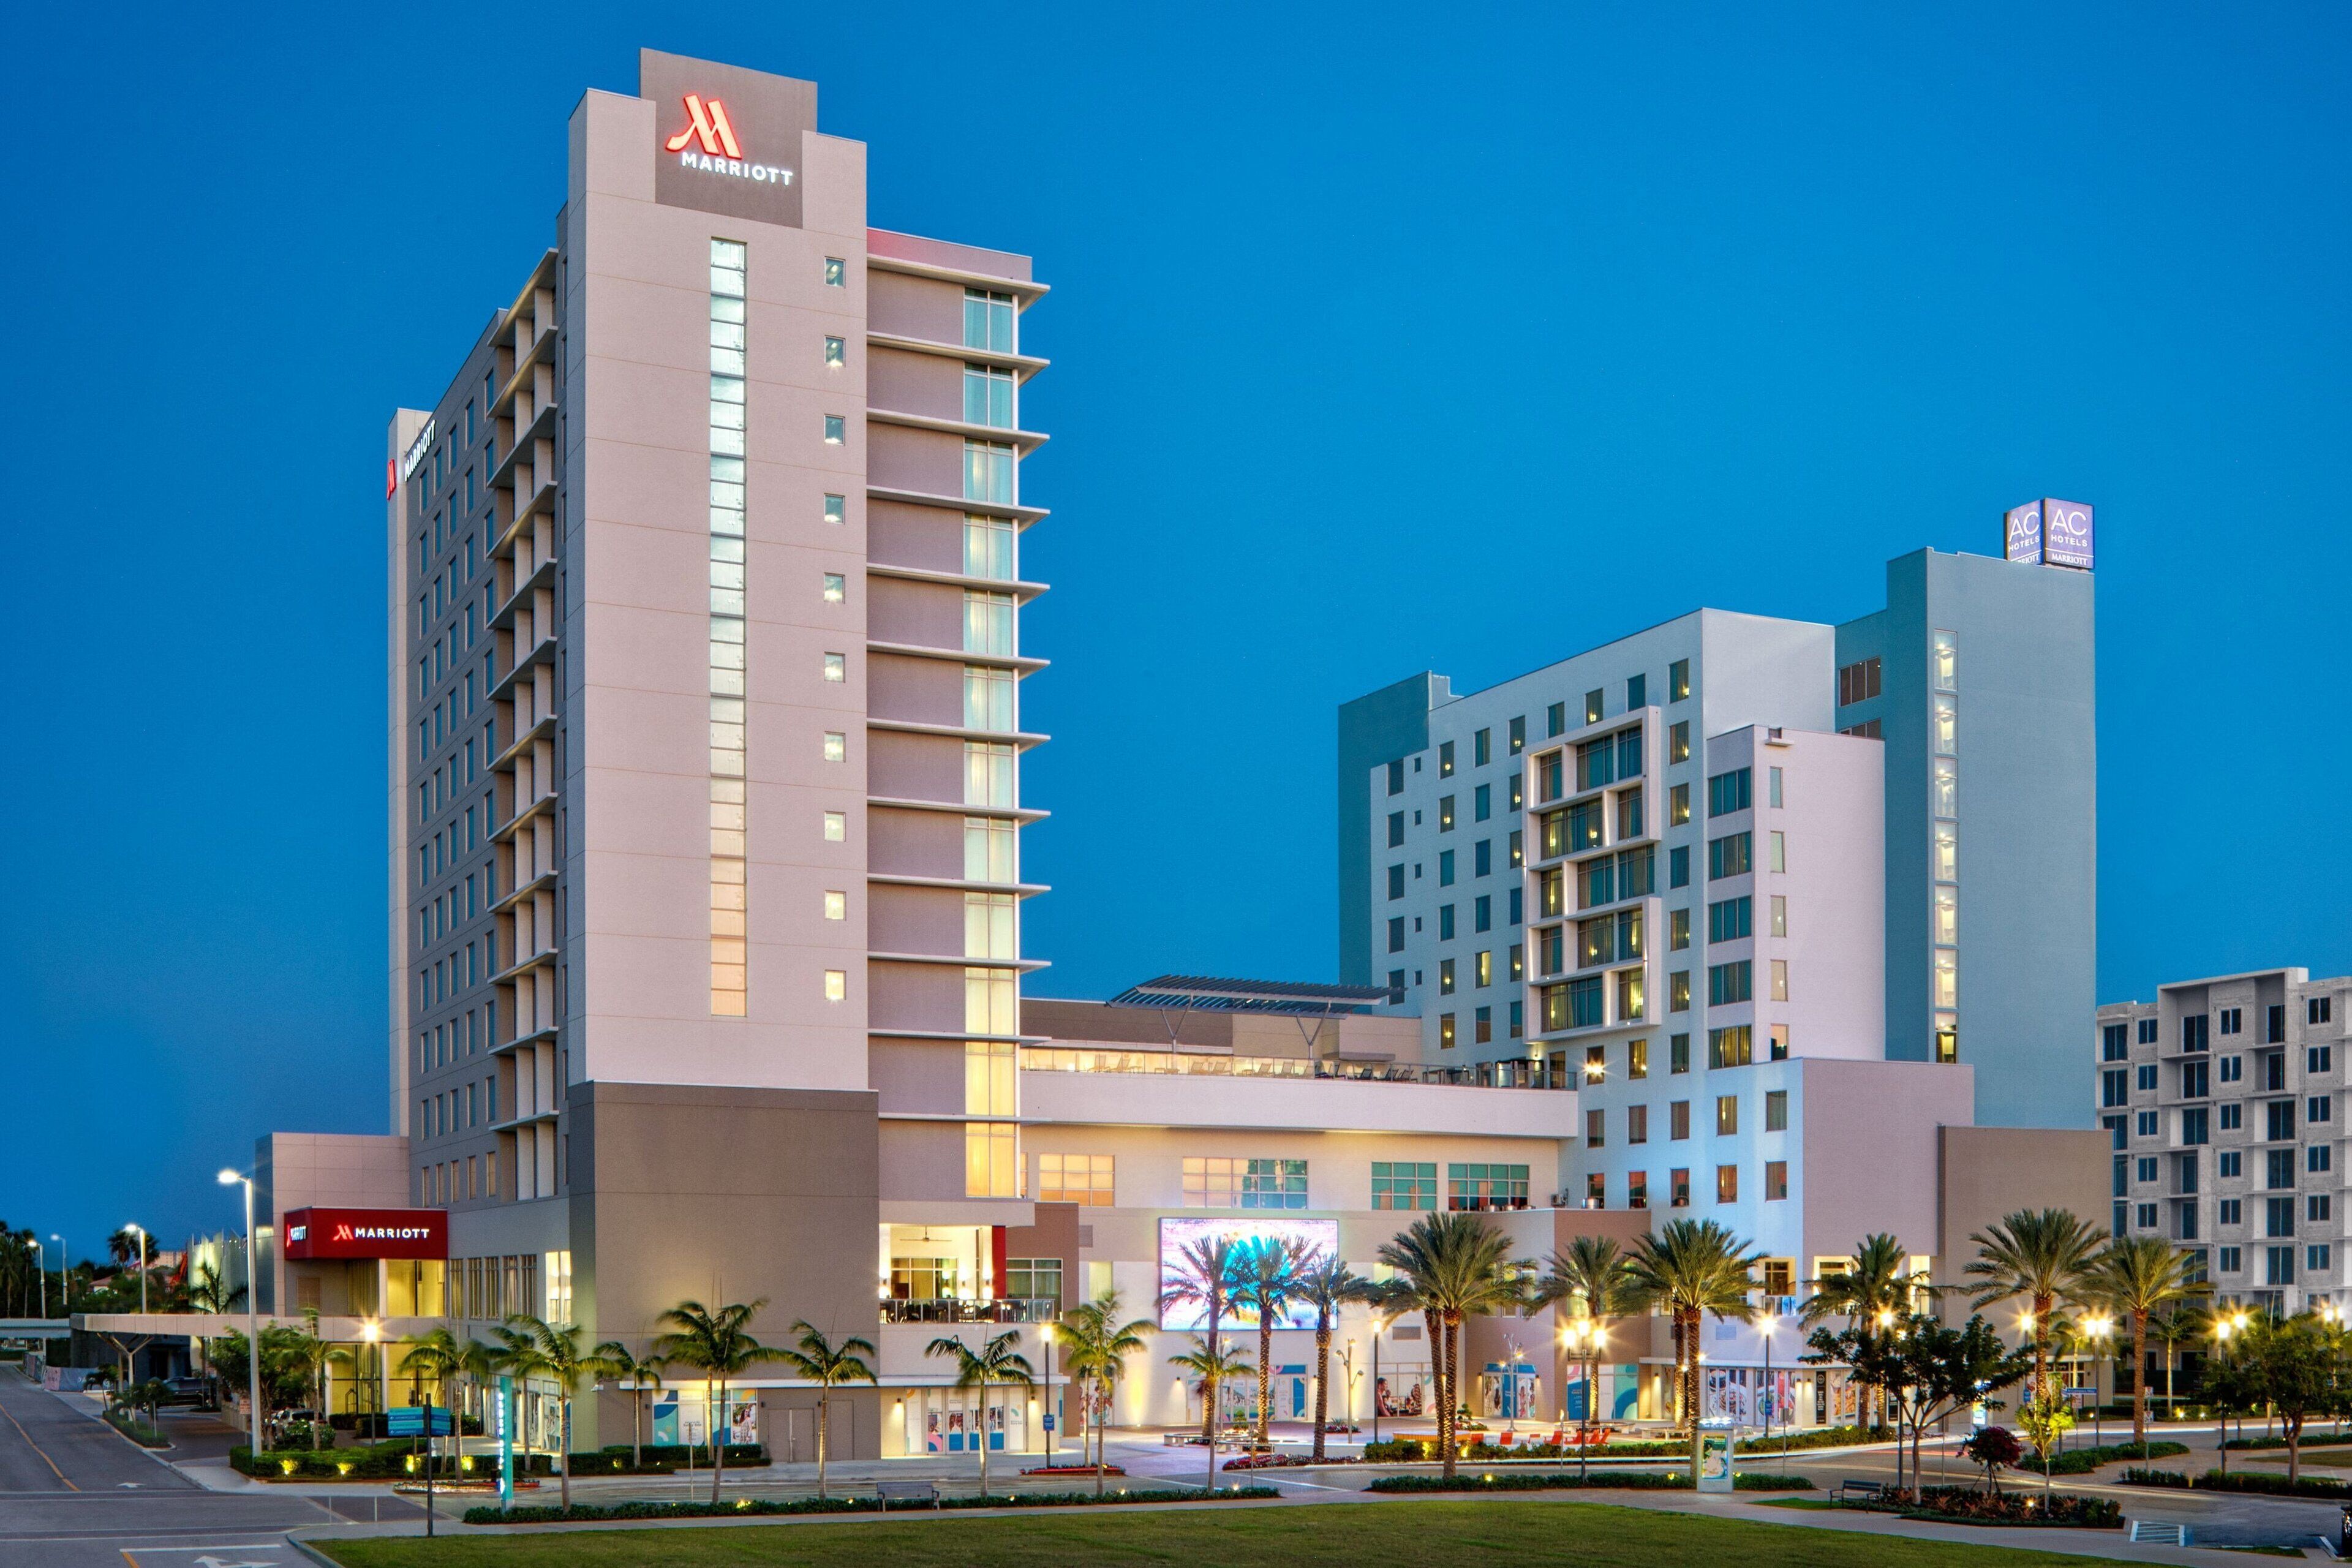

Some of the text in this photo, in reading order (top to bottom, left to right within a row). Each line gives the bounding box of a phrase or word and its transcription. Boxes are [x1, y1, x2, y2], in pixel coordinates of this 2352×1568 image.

[681, 151, 793, 186] MARRIOTT
[405, 419, 436, 482] MARRIOTT
[2008, 511, 2040, 542] AC
[2051, 508, 2087, 536] AC
[2008, 535, 2040, 552] HOTELS
[2051, 534, 2088, 548] HOTELS
[2052, 552, 2087, 565] MARRIOTT
[355, 1227, 430, 1239] MARRIOTT
